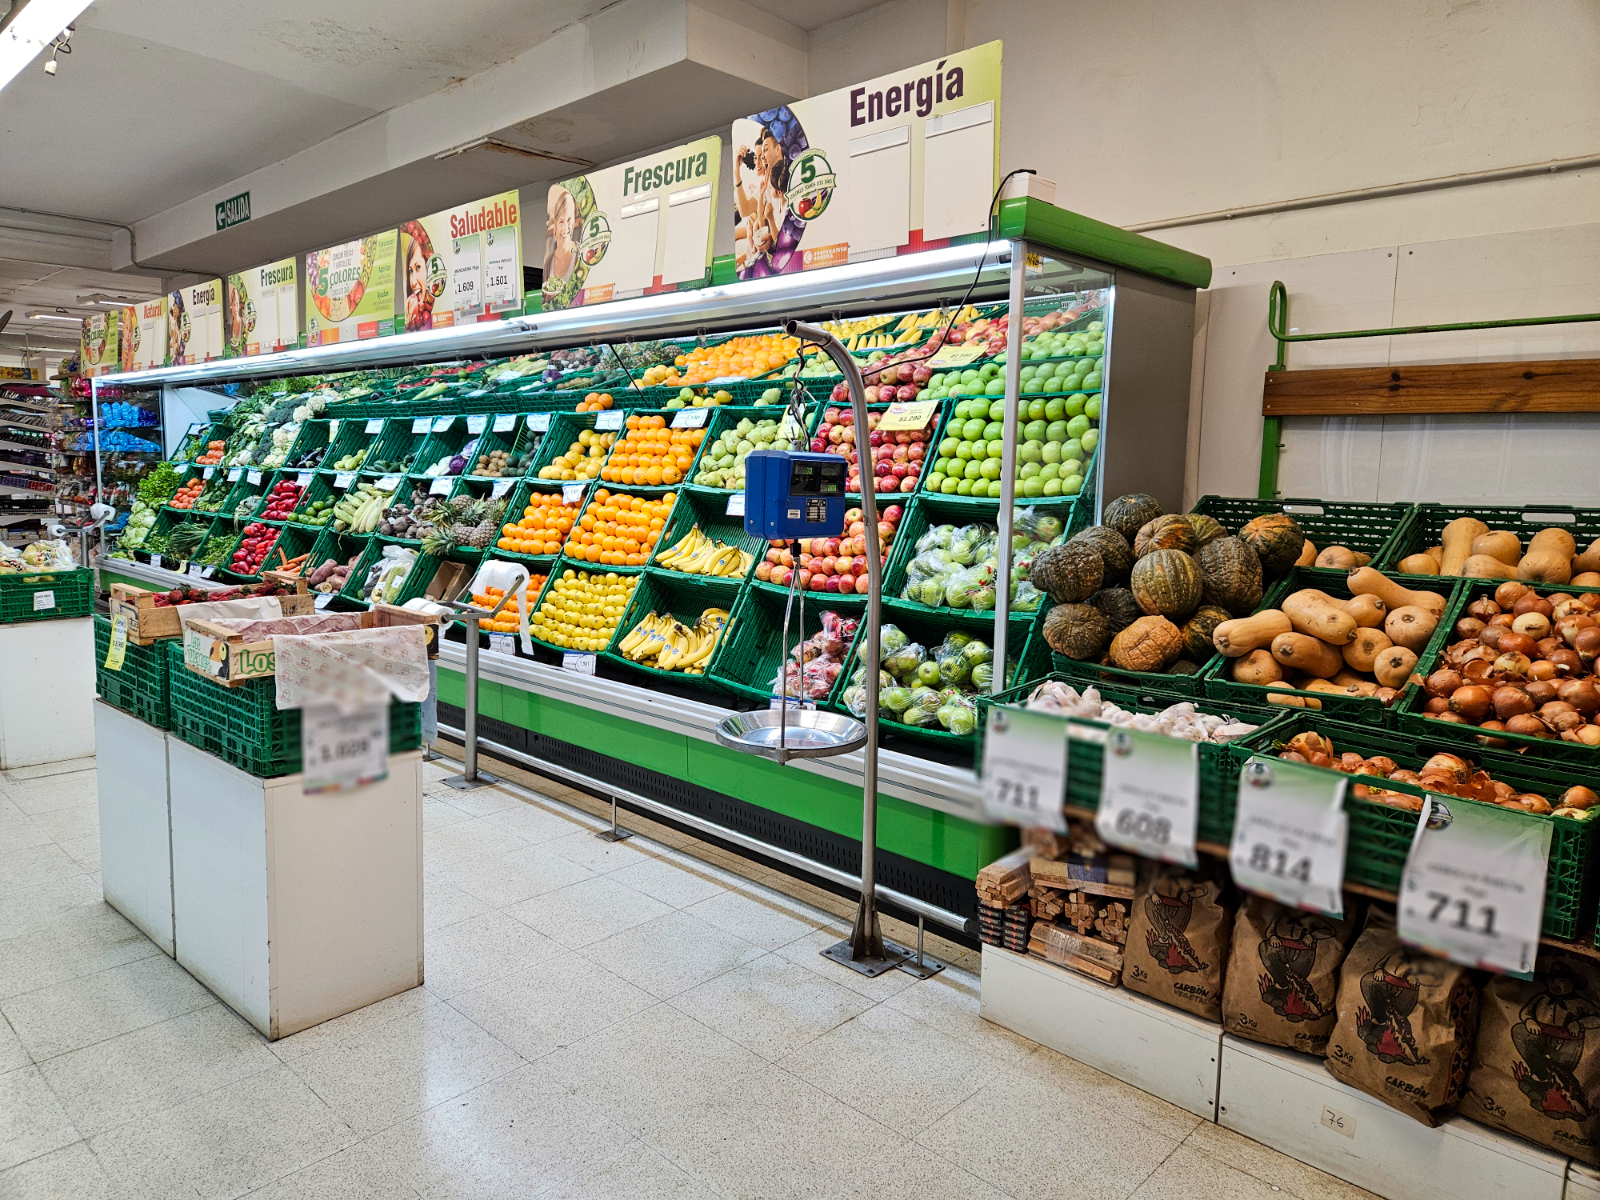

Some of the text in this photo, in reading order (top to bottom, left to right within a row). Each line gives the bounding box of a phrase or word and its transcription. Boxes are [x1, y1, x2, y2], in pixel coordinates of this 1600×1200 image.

[850, 59, 964, 127] Energía
[623, 151, 708, 197] Frescura
[801, 155, 816, 184] 5
[226, 195, 250, 224] SALIDA
[450, 199, 518, 239] Saludable
[589, 216, 600, 238] 5
[261, 265, 294, 287] Frescura
[432, 257, 439, 275] 5
[193, 284, 215, 306] Energía
[318, 267, 329, 296] 5
[330, 266, 361, 286] COLORES
[457, 280, 474, 293] 1.609
[490, 275, 508, 287] 1.501
[144, 304, 162, 319] Natural
[996, 777, 1041, 810] 711
[1114, 807, 1173, 846] 608
[1248, 842, 1312, 885] 814
[1425, 891, 1502, 938] 711
[1385, 1075, 1430, 1099] CARBÓN
[1326, 1109, 1344, 1128] 76
